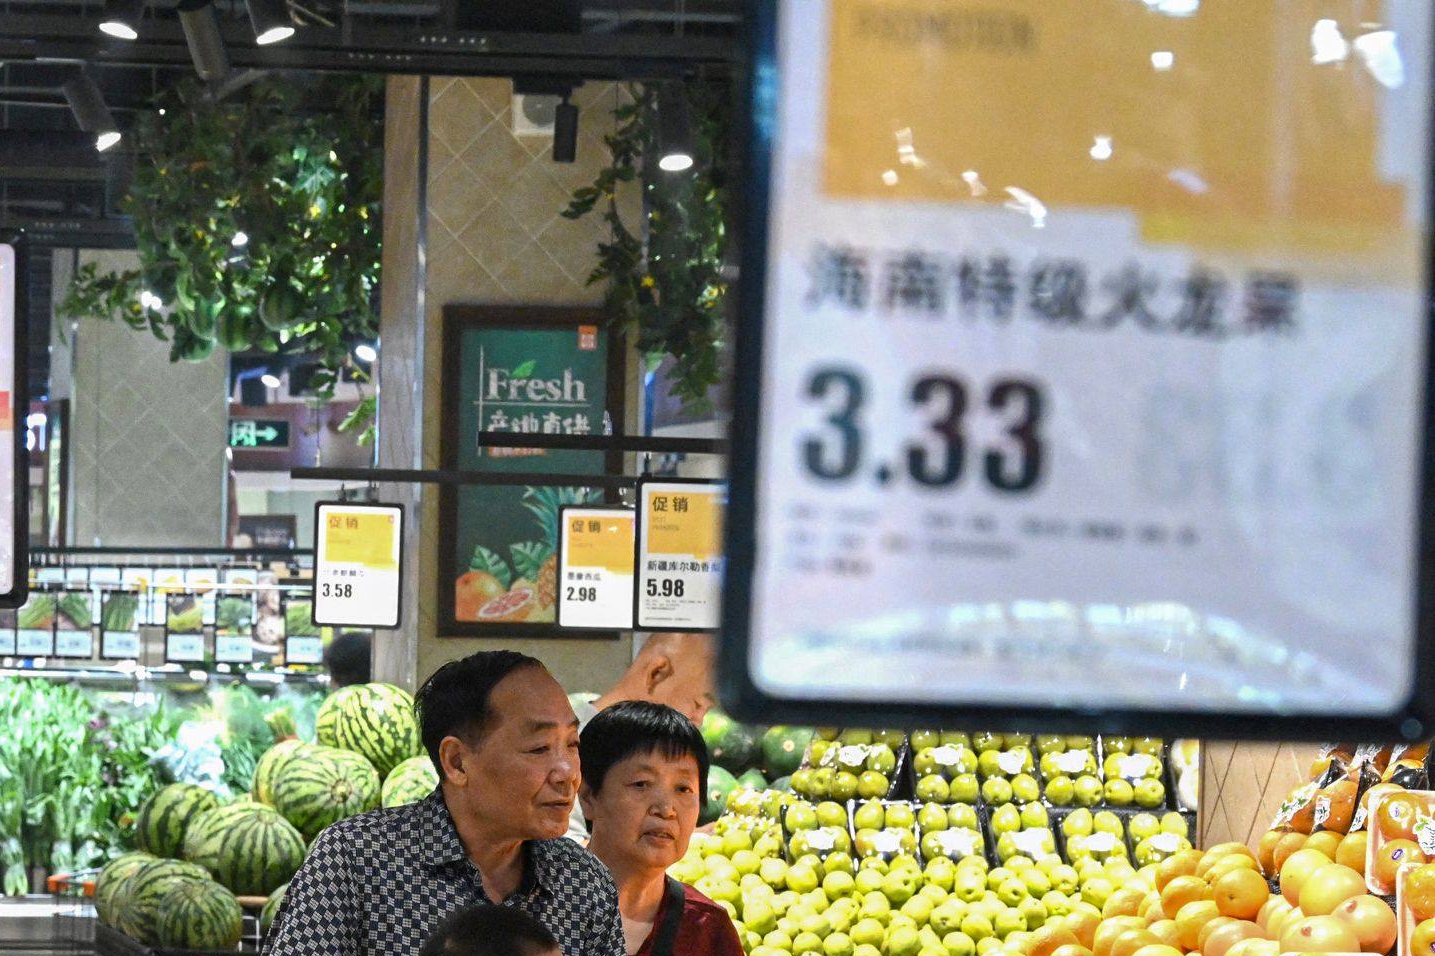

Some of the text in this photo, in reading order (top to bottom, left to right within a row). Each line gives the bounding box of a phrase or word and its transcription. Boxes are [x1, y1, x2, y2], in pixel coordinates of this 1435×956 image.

[485, 367, 587, 401] Fresh
[800, 362, 1051, 494] 3.33
[652, 497, 689, 513] 促销
[322, 582, 353, 598] 3.58
[566, 586, 597, 602] 2.98
[646, 578, 685, 598] 5.98
